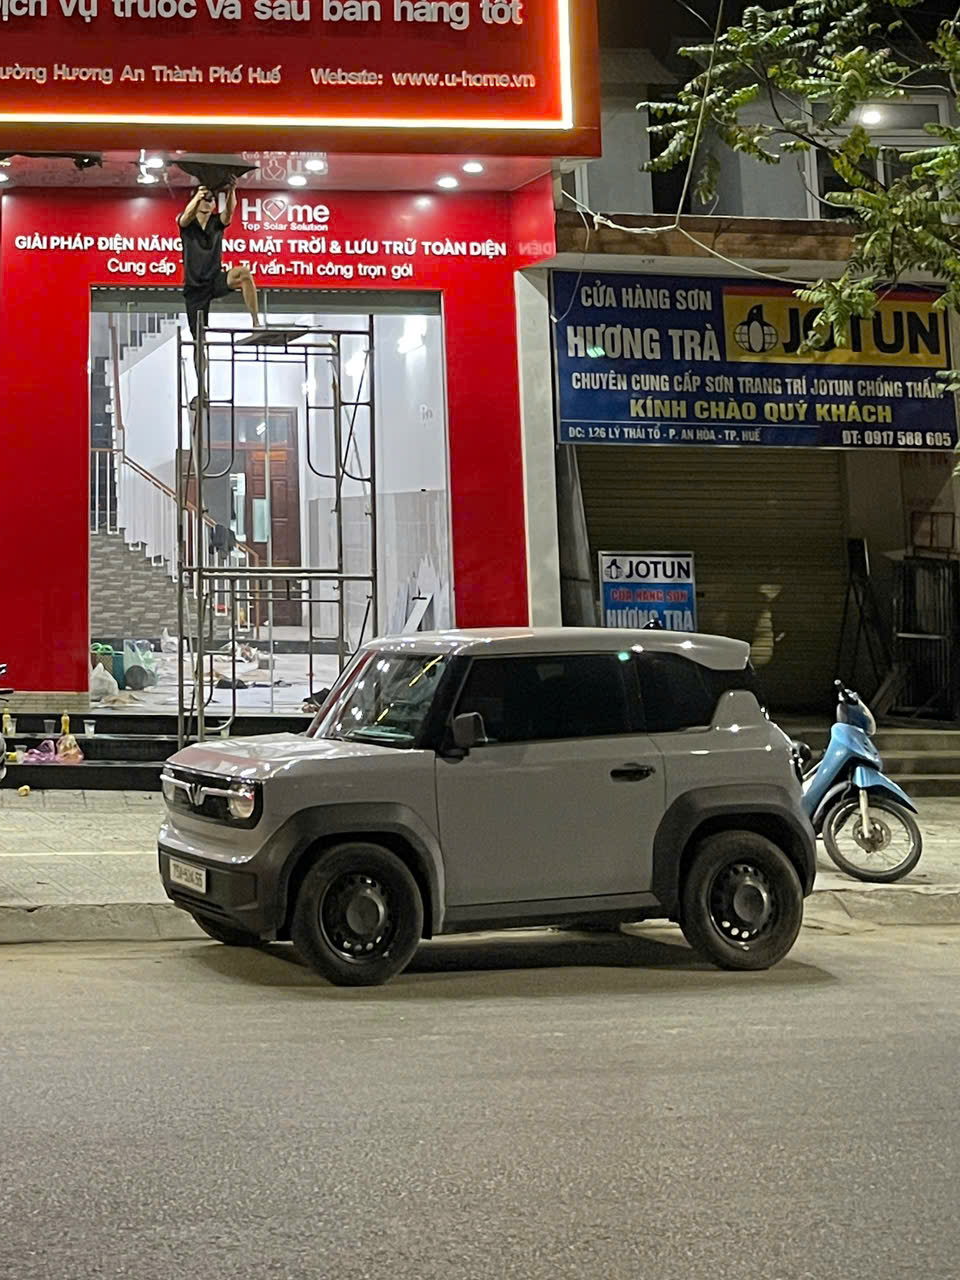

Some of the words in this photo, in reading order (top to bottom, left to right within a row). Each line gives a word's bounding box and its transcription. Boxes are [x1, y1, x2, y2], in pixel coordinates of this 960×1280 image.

[53, 63, 113, 85] Hương
[120, 65, 145, 82] An
[152, 64, 203, 82] Thành
[209, 64, 243, 83] Phố
[248, 64, 282, 84] Huế
[311, 68, 383, 85] Website:
[391, 70, 537, 88] www.u-home.vn
[242, 222, 261, 231] Top
[264, 222, 288, 231] Solar
[290, 222, 328, 231] Solution
[15, 232, 47, 250] GIẢI
[50, 233, 94, 250] PHÁP
[97, 233, 134, 254] ĐIỆN
[138, 234, 184, 251] NĂNG
[249, 236, 283, 256] MẶT
[287, 236, 326, 254] TRỜI
[329, 240, 342, 254] &
[345, 238, 379, 255] LƯU
[382, 238, 418, 256] TRỮ
[421, 238, 469, 256] TOÀN
[470, 239, 507, 258] DIỆN
[107, 257, 146, 275] Cung
[149, 257, 176, 276] cấp
[317, 261, 353, 279] công
[358, 262, 386, 279] trọn
[391, 263, 413, 280] gói
[581, 280, 617, 308] CỬA
[622, 284, 671, 310] HÀNG
[676, 288, 712, 311] SƠN
[566, 324, 661, 360] HƯƠNG
[668, 324, 721, 361] TRÀ
[572, 370, 627, 391] CHUYÊN
[631, 374, 669, 391] CUNG
[674, 369, 701, 392] CẤP
[705, 375, 734, 394] SƠN
[737, 377, 782, 395] TRANG
[785, 376, 807, 395] TRÍ
[811, 378, 854, 397] JOTUN
[857, 375, 903, 398] CHỐNG
[630, 395, 687, 418] KÍNH
[695, 397, 757, 421] CHÀO
[764, 400, 808, 423] QUÝ
[816, 401, 892, 424] KHÁCH
[589, 427, 606, 439] 126
[623, 425, 646, 440] THÁI
[681, 428, 695, 440] AN
[724, 428, 740, 441] TP.
[741, 427, 762, 442] HUẾ
[864, 431, 893, 445] 0917
[897, 431, 923, 446] 588
[926, 432, 951, 447] 605
[626, 561, 690, 579] JOTUN
